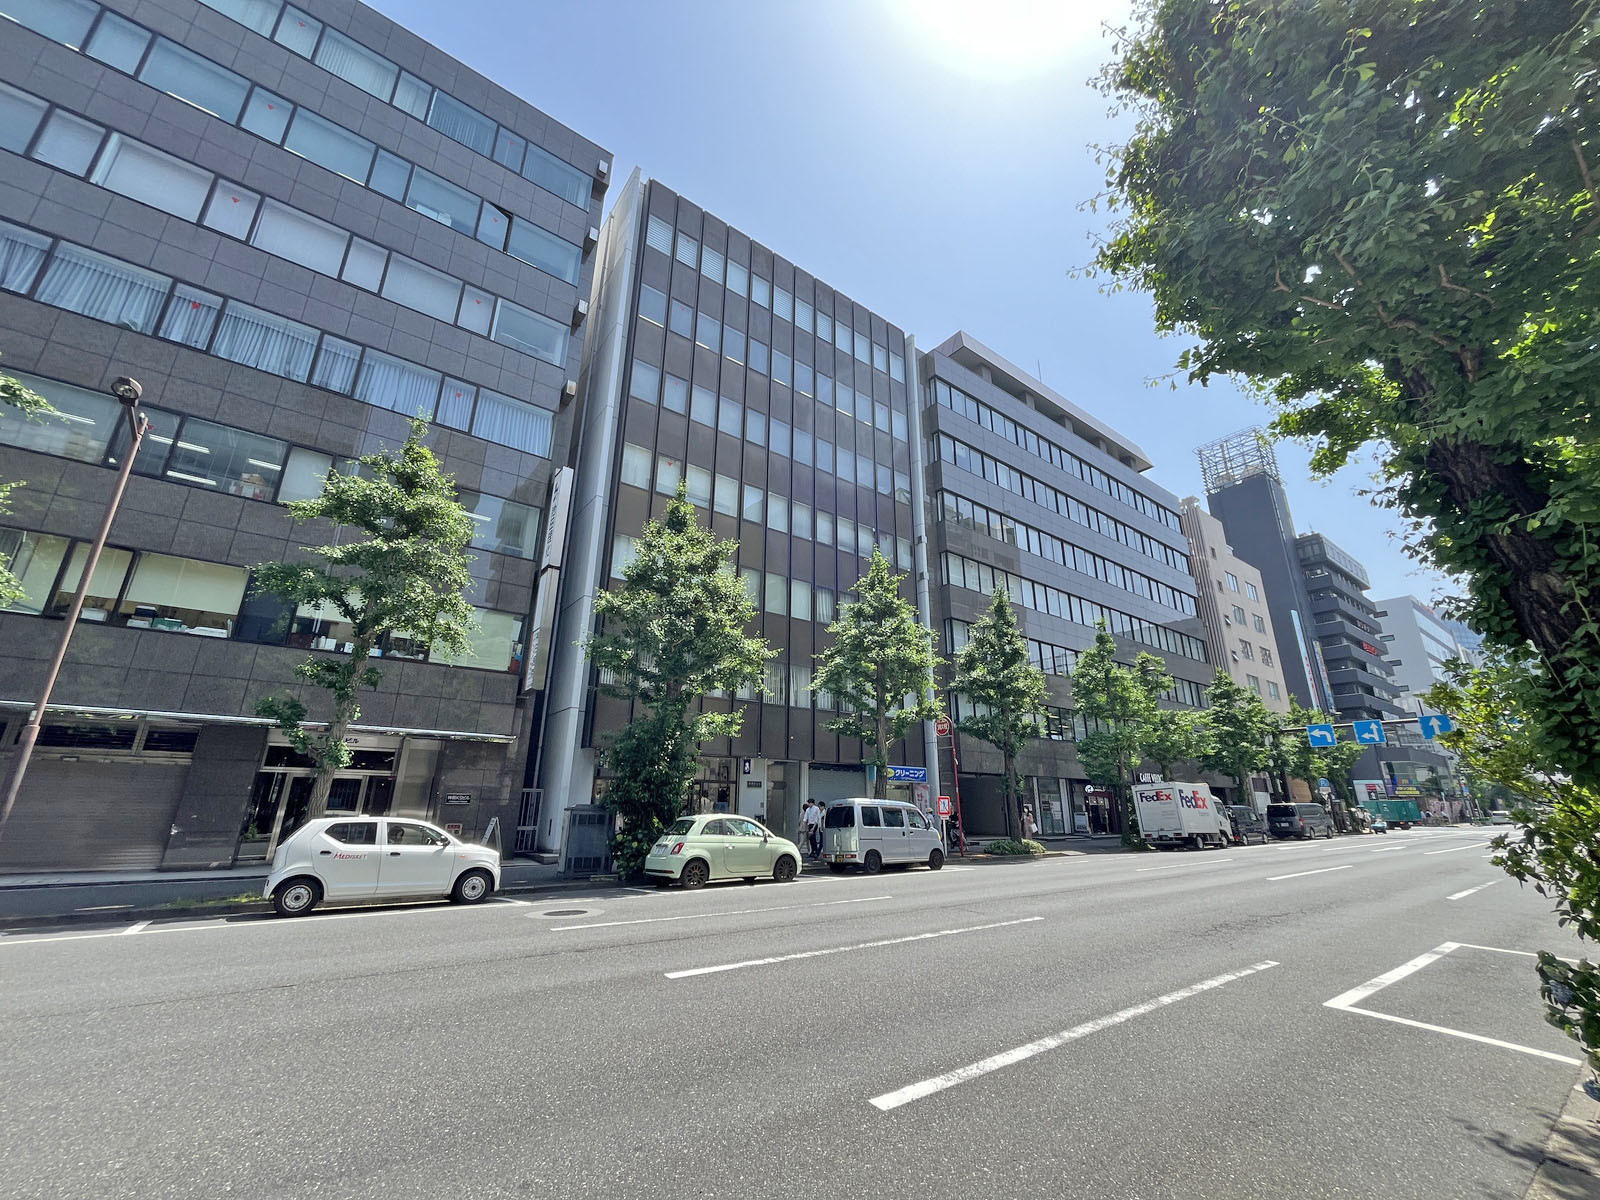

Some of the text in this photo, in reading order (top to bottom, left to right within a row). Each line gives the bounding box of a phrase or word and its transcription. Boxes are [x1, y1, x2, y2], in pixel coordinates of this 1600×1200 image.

[895, 769, 925, 778] クリーニング
[1139, 791, 1173, 802] FedEx
[1178, 788, 1209, 810] FedEx
